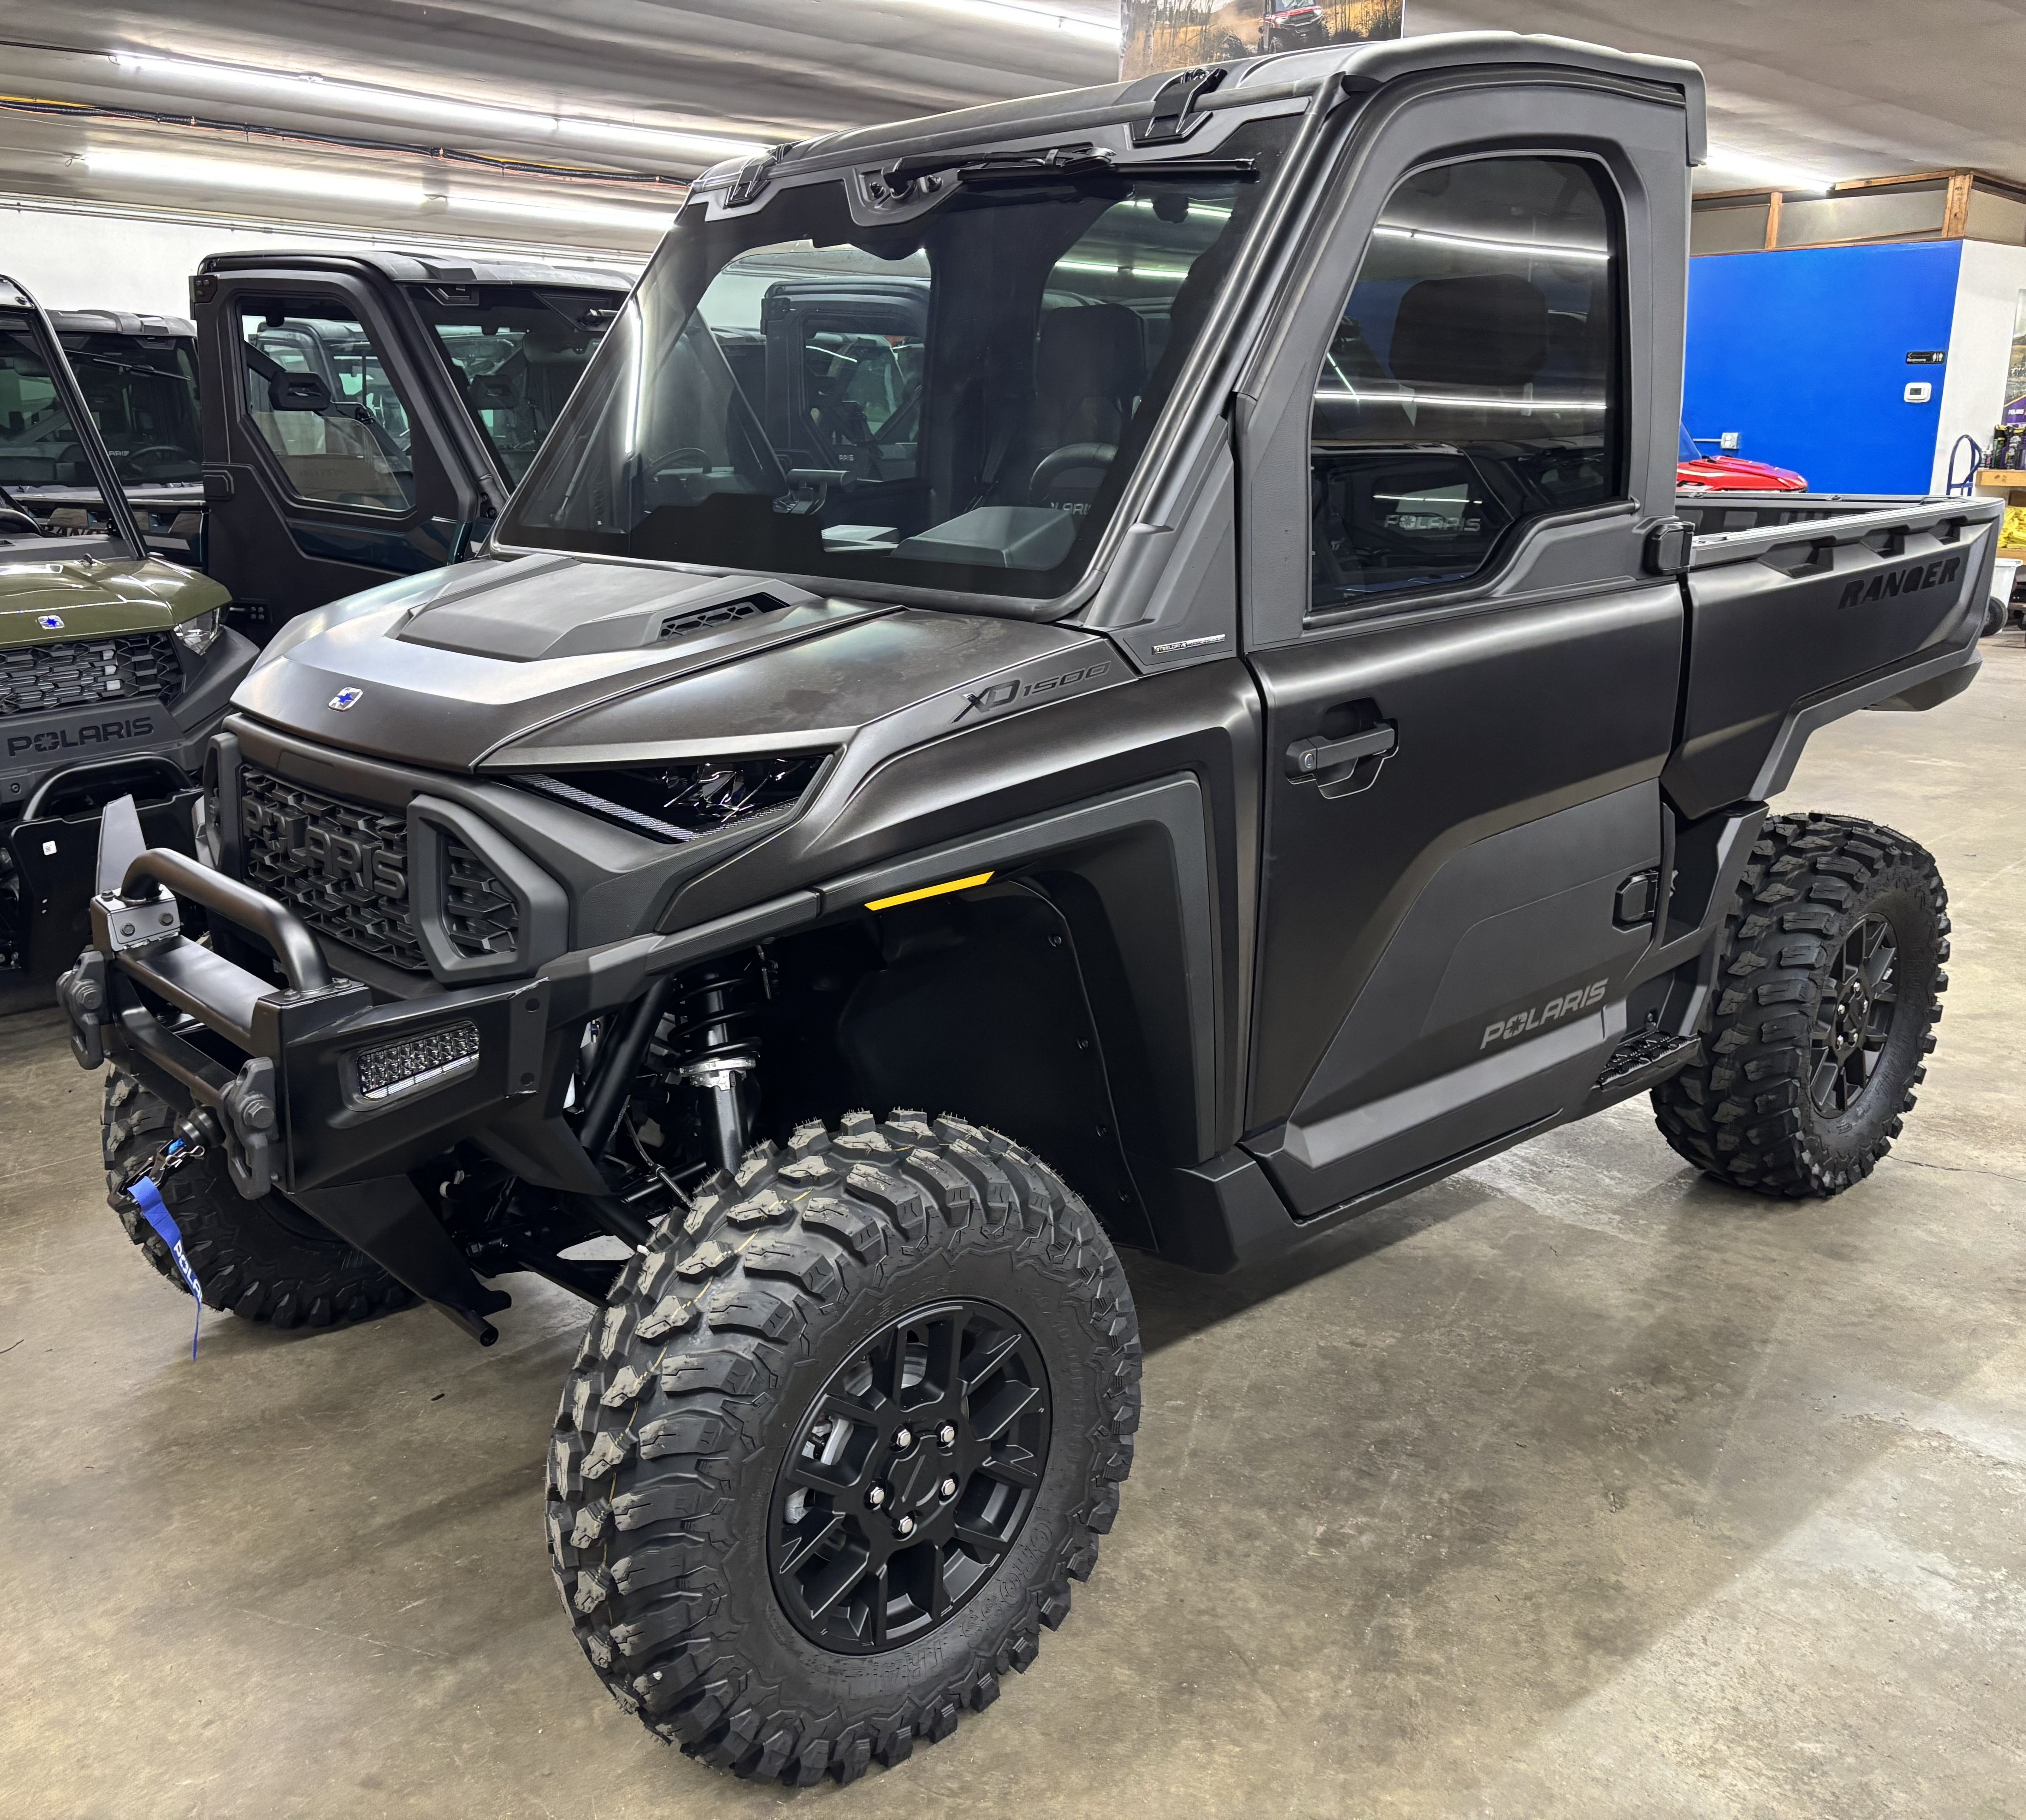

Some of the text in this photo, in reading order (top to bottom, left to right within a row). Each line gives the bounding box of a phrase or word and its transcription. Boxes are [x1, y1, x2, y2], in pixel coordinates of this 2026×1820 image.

[1384, 514, 1482, 532] POLARIS
[1837, 556, 1961, 610] RANGER
[7, 716, 154, 757] POLARIS
[1480, 978, 1609, 1050] POLARIS
